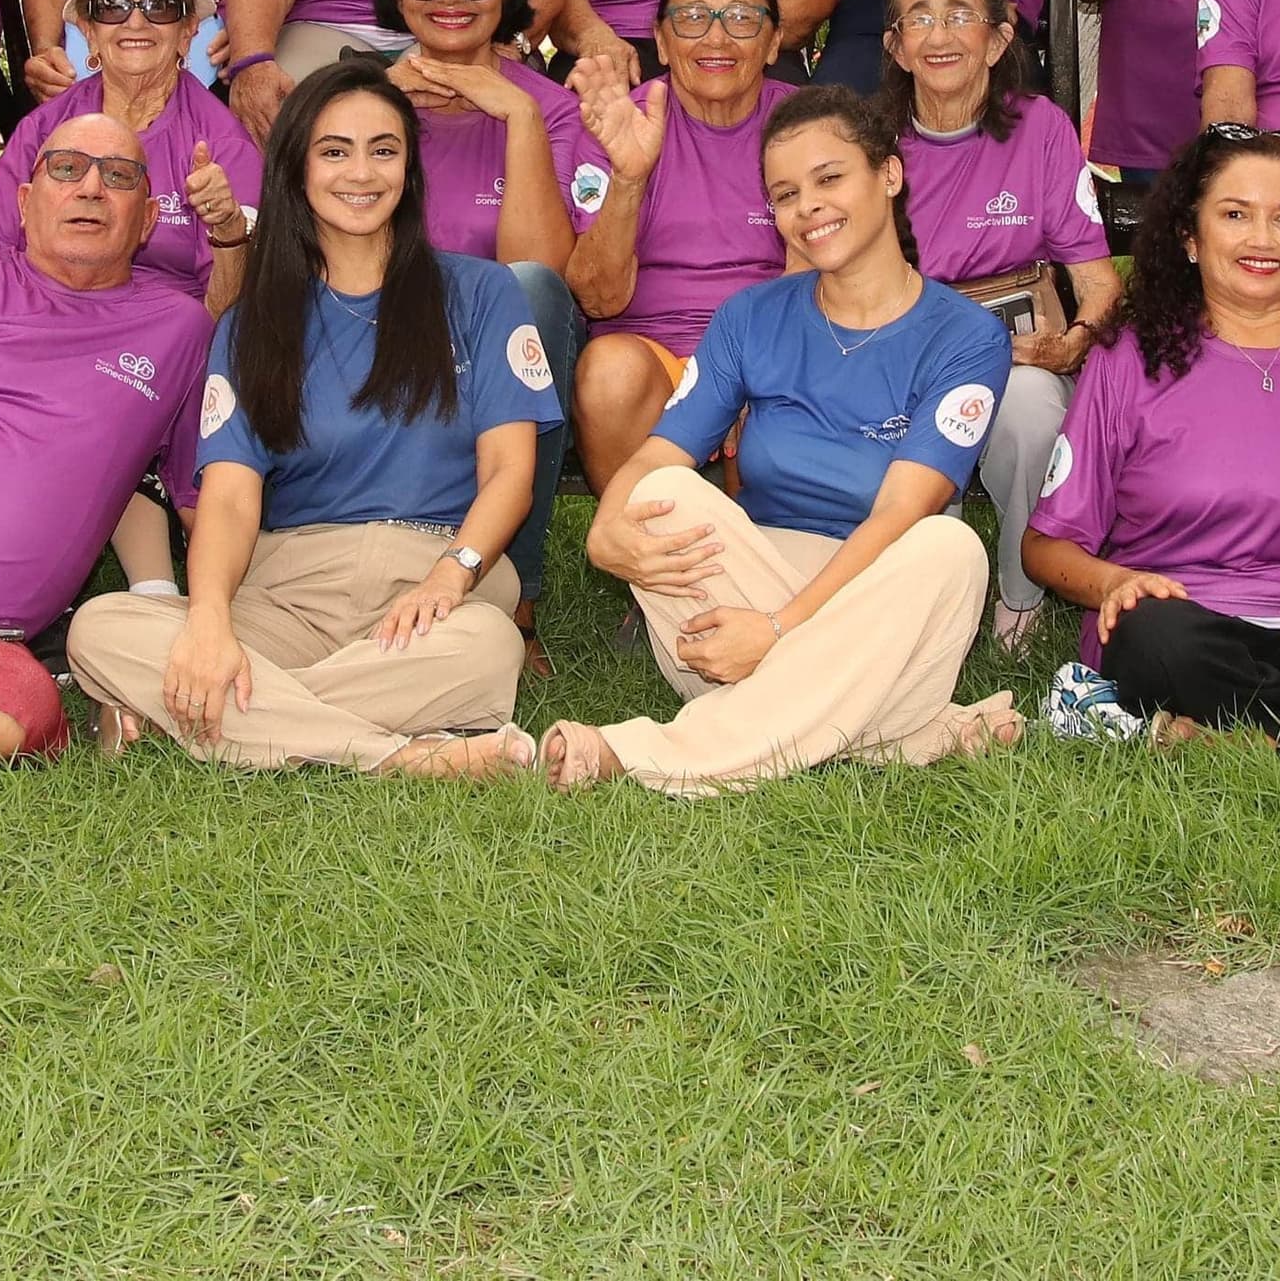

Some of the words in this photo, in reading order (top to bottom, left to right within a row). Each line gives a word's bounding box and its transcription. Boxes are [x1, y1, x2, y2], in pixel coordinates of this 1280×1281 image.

[94, 363, 154, 401] conectivIDADE
[522, 368, 550, 378] ITEVA
[942, 416, 975, 440] ITEVA
